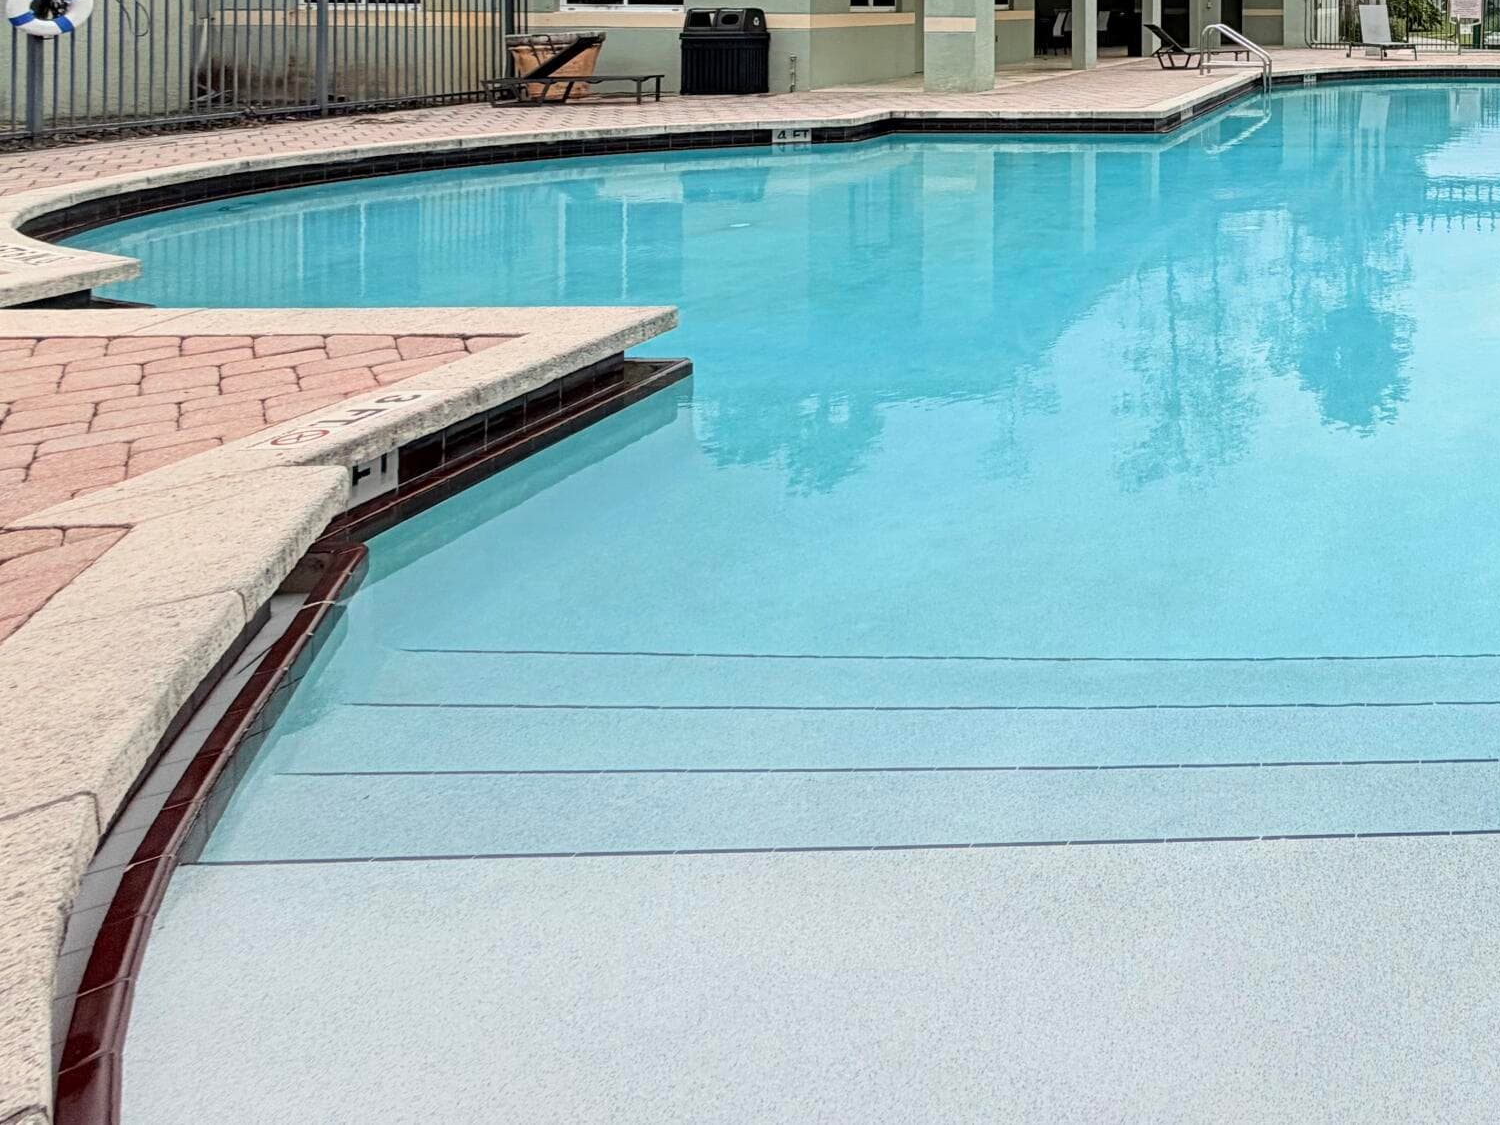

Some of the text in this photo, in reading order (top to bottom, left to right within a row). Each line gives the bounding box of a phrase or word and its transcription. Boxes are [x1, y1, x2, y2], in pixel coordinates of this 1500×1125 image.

[777, 129, 810, 140] 4 FT
[375, 394, 422, 404] 3
